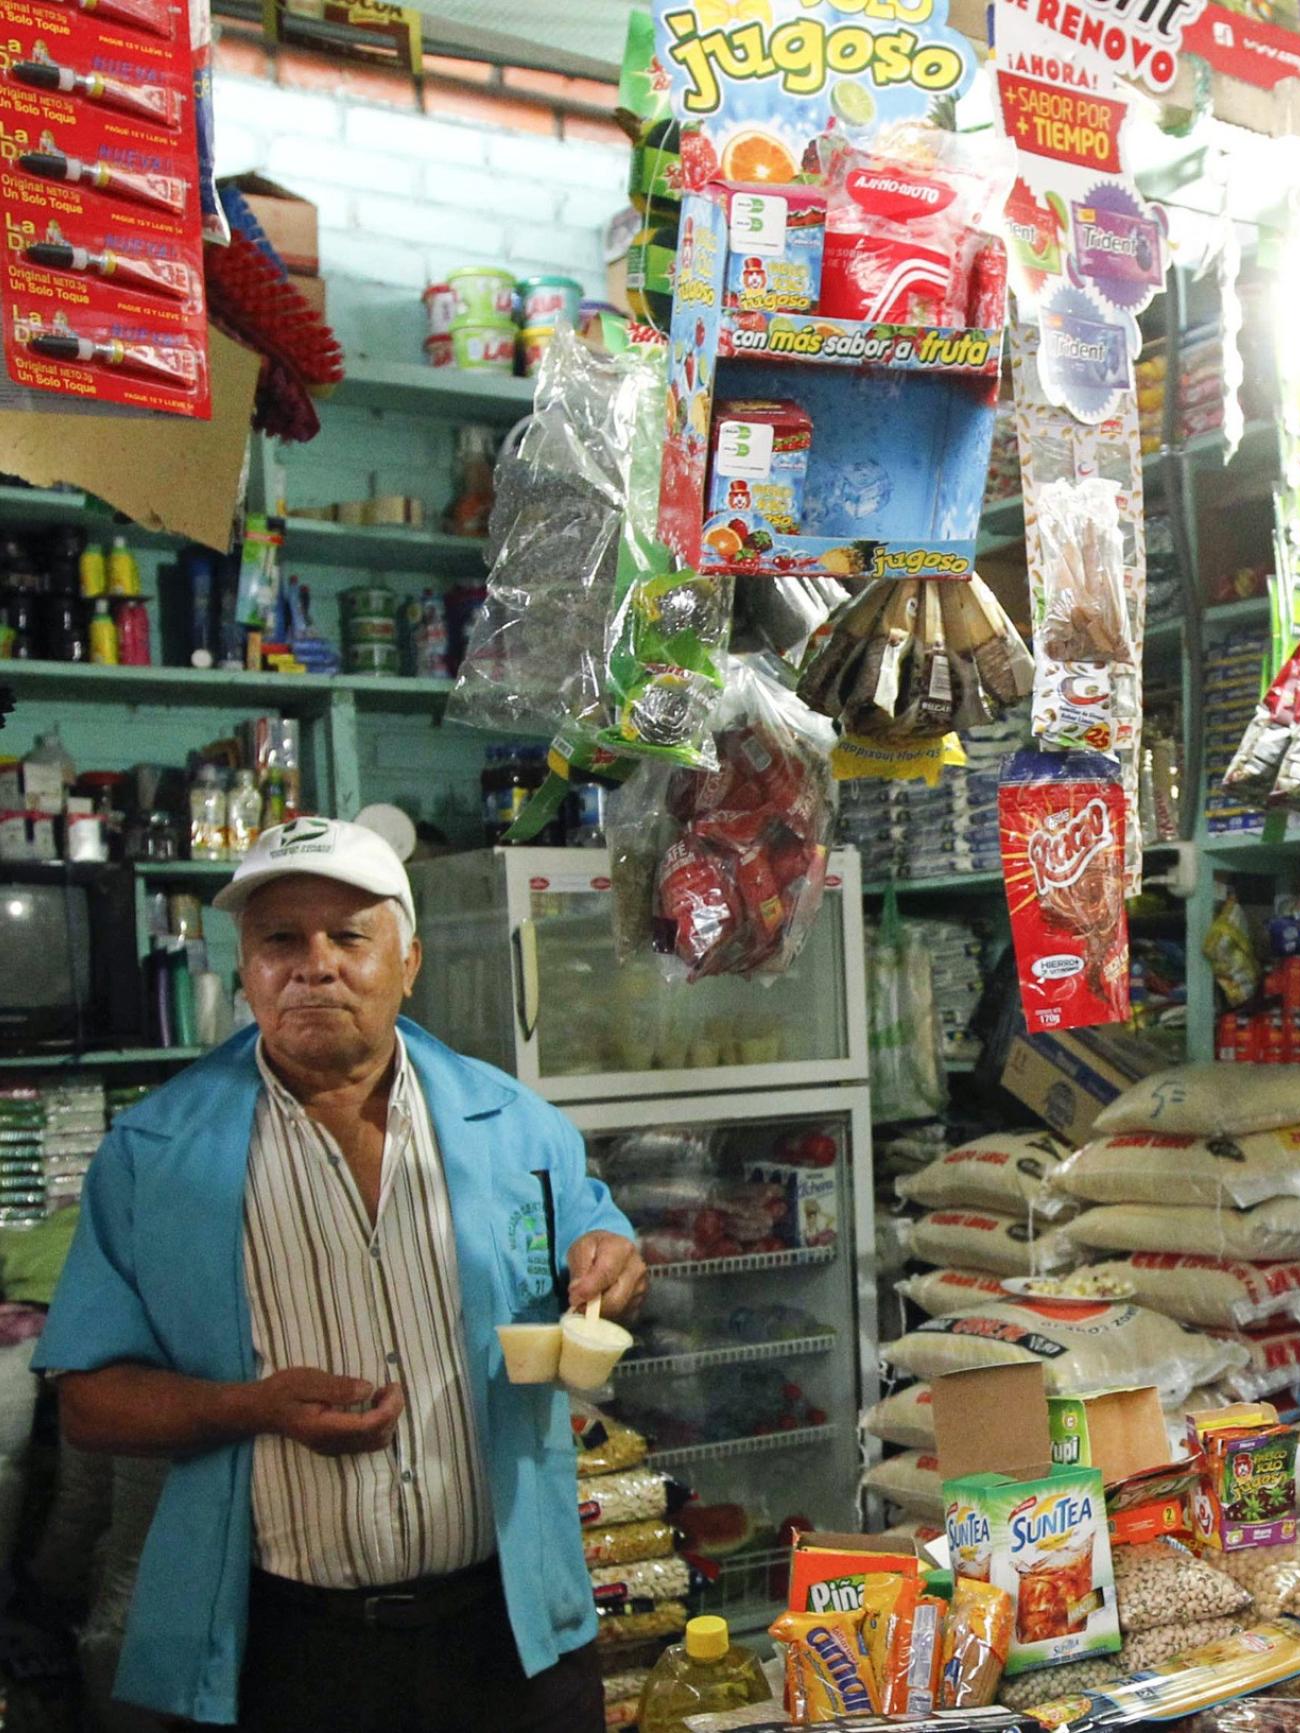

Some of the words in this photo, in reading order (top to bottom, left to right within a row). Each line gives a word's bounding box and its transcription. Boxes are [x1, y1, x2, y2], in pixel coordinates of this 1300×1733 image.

[7, 11, 34, 27] Solo
[36, 15, 71, 36] Toque
[1036, 0, 1175, 83] RENOVO
[665, 9, 963, 112] jugoso
[15, 102, 41, 116] Solo
[43, 106, 77, 125] Toque
[1077, 100, 1113, 130] POR
[0, 121, 29, 143] La
[1033, 116, 1110, 160] TIEMPO
[1, 174, 46, 193] Original
[3, 188, 18, 202] Un
[20, 190, 48, 208] Solo
[51, 200, 84, 215] Toque
[6, 212, 36, 235] La
[1083, 225, 1138, 257] Trident
[8, 266, 51, 284] Original
[9, 278, 26, 291] Un
[28, 281, 54, 297] Solo
[55, 287, 90, 304] Toque
[13, 304, 42, 325] La
[732, 330, 768, 349] con
[768, 326, 824, 353] más
[824, 333, 893, 359] sabor
[894, 340, 913, 359] a
[918, 332, 991, 366] fruta
[1051, 332, 1107, 362] Trident
[15, 357, 57, 376] Original
[17, 370, 34, 383] Un
[35, 374, 61, 390] Solo
[63, 377, 97, 394] Toque
[872, 547, 969, 578] jugoso
[1085, 727, 1111, 749] 25
[1039, 1013, 1062, 1025] 170g
[1011, 1497, 1093, 1553] SUNTEA
[1166, 1506, 1173, 1521] 2
[948, 1513, 991, 1551] SUNTEA
